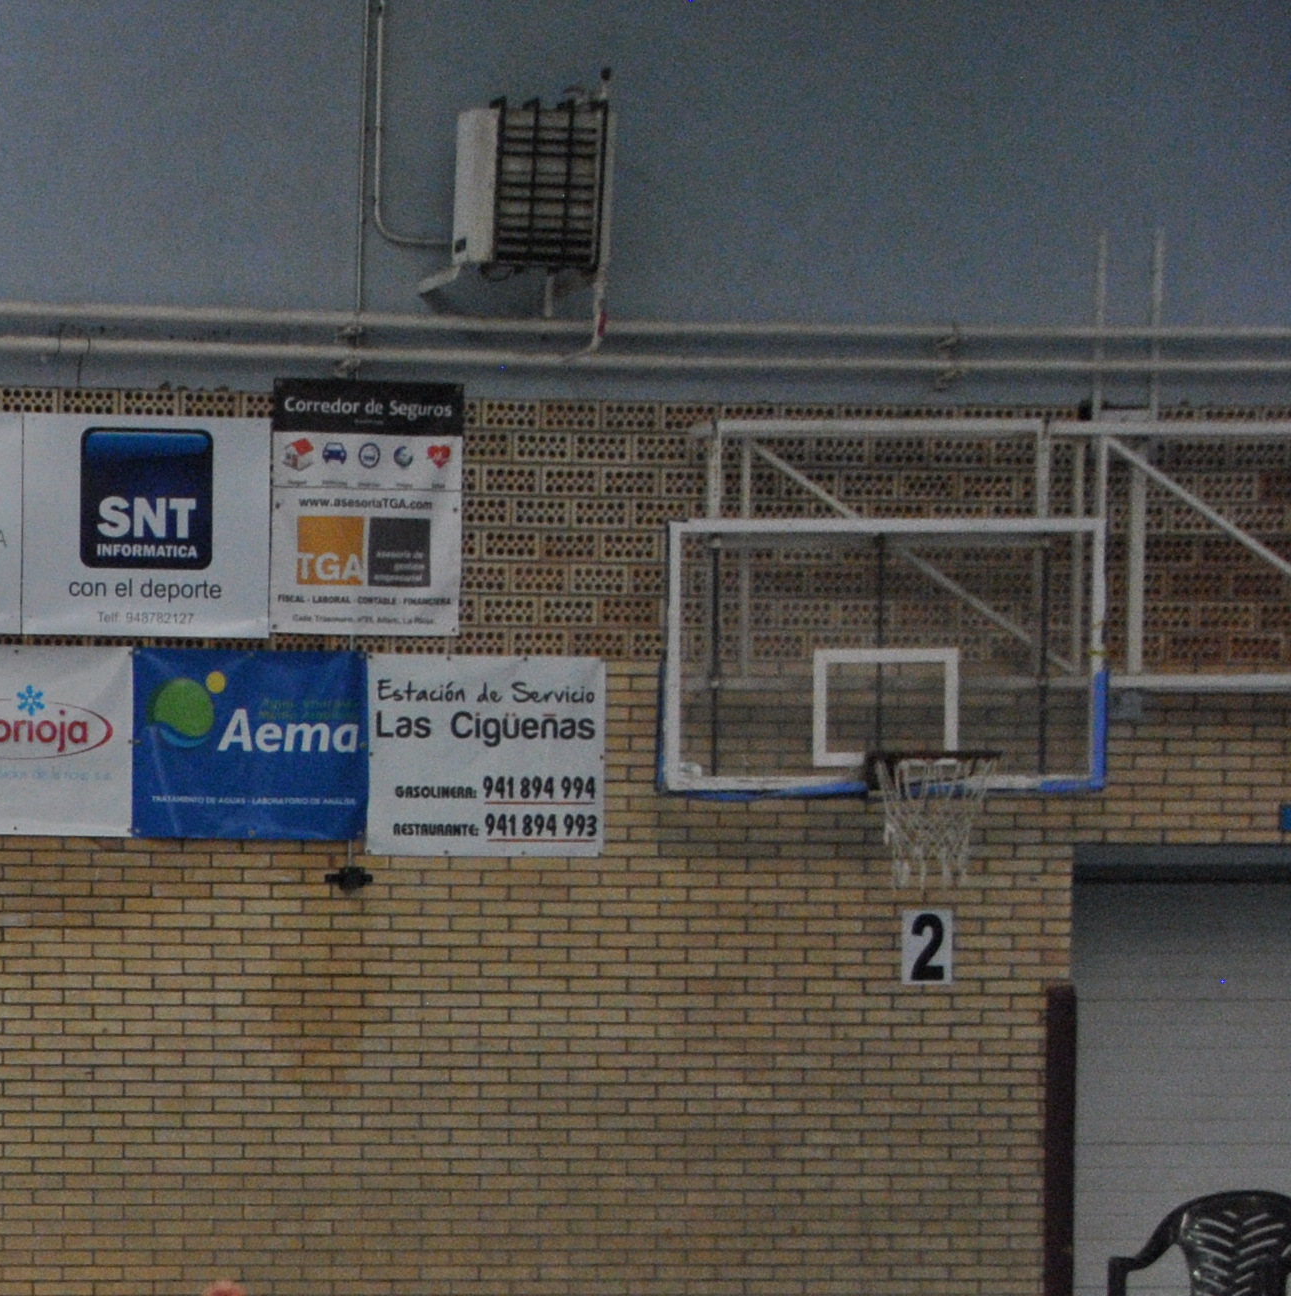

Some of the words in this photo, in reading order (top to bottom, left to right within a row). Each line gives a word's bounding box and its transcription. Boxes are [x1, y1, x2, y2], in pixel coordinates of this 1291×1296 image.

[284, 397, 360, 413] Corredor
[365, 399, 383, 415] de
[389, 401, 453, 420] Seguros
[97, 496, 196, 538] SNT
[97, 543, 197, 558] INFORMATICA
[297, 552, 363, 581] TGA
[69, 581, 107, 597] con
[115, 579, 132, 597] el
[141, 579, 222, 603] deporte
[278, 594, 305, 603] FISCAL
[312, 595, 351, 604] LABORAL
[358, 596, 396, 605] CONTABLE
[377, 679, 465, 702] Estación
[477, 683, 502, 703] de
[512, 681, 595, 704] Servicio
[218, 709, 358, 752] Aema
[376, 711, 431, 738] Las
[451, 711, 595, 747] Cigüeñas
[395, 786, 477, 798] GASOLINERA:
[483, 776, 514, 799] 941
[521, 776, 554, 799] 894
[561, 776, 596, 799] 994
[152, 795, 204, 804] TRATAMIENTO
[206, 796, 216, 804] DE
[218, 796, 246, 805] AGUAS
[252, 797, 307, 805] LABORATORIO
[393, 823, 479, 836] RESTAURANTE:
[485, 814, 516, 836] 941
[523, 814, 556, 836] 894
[564, 814, 597, 837] 993
[910, 913, 945, 980] 2
